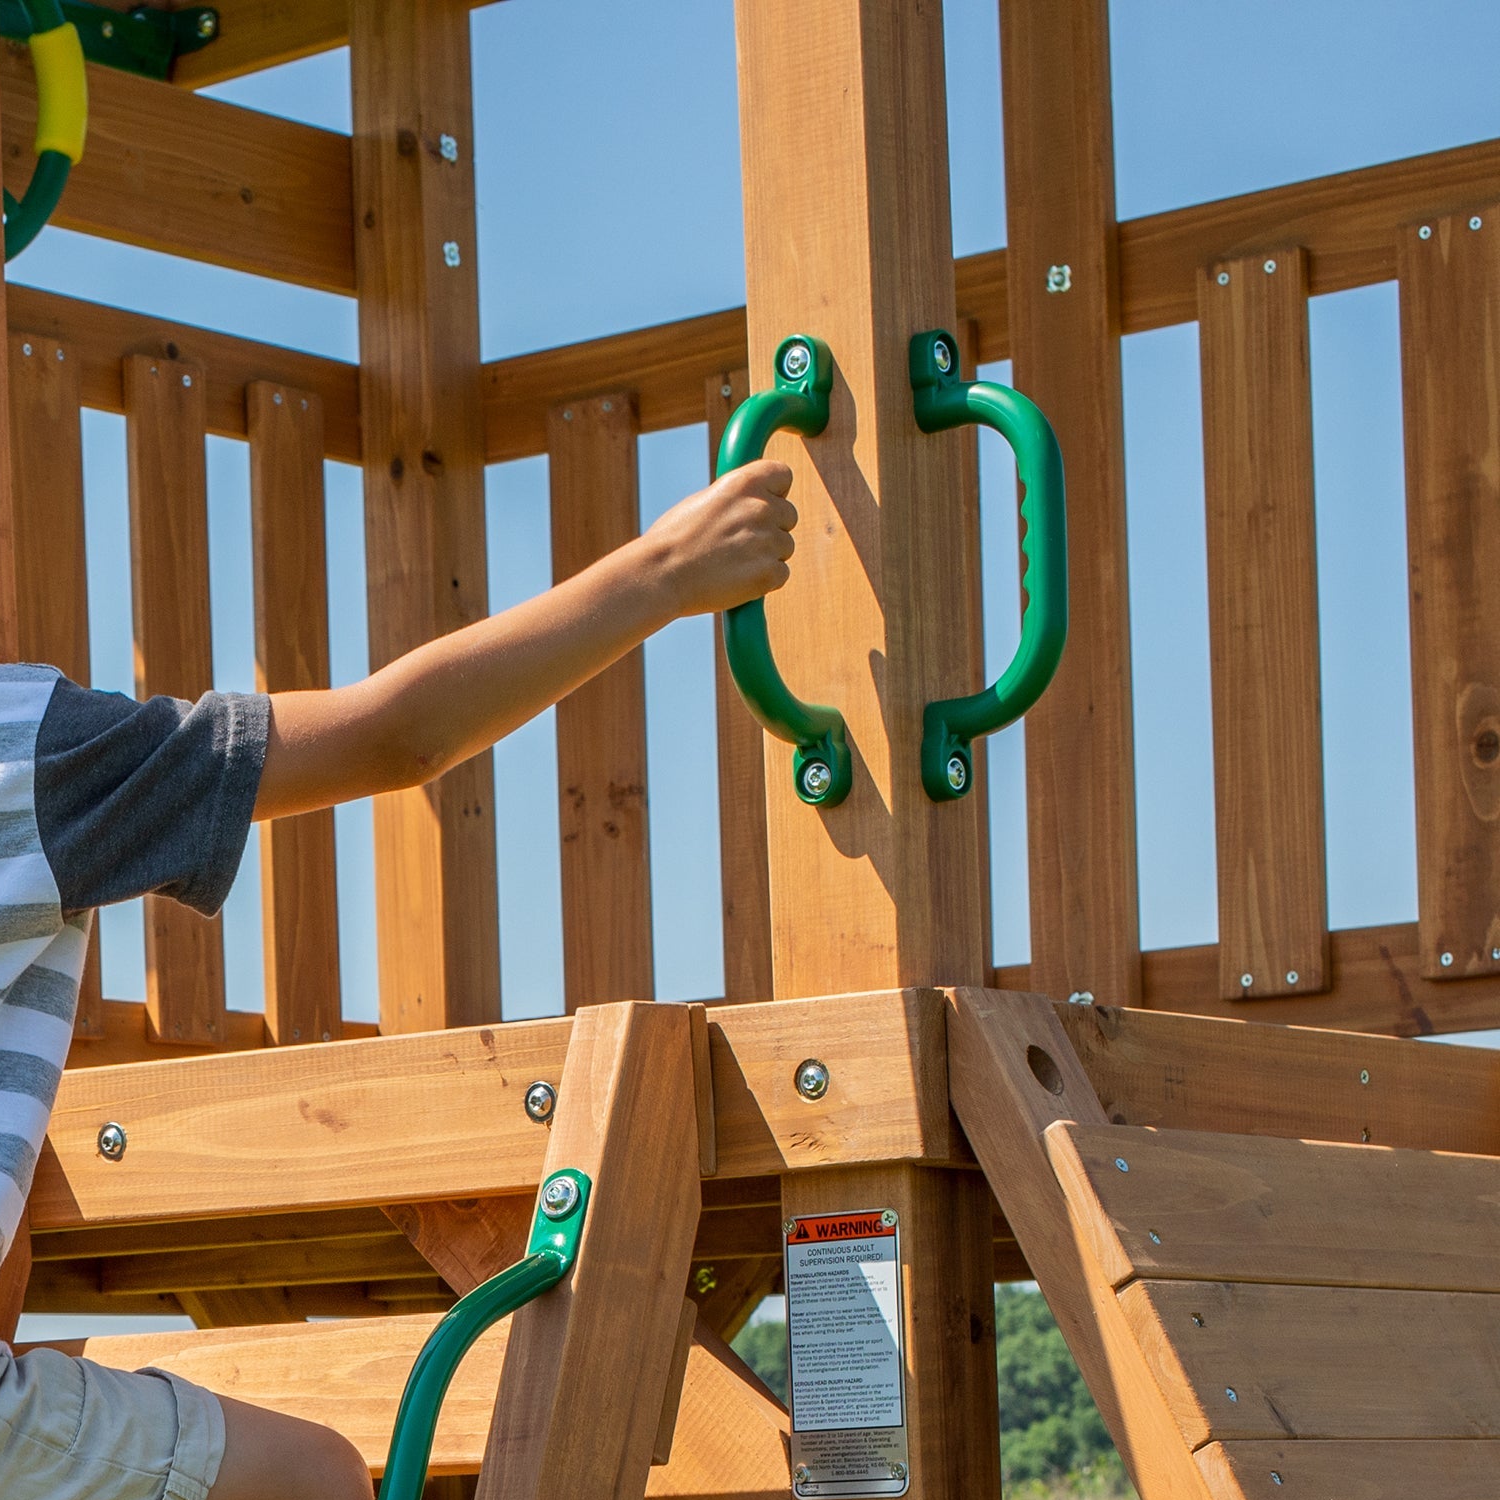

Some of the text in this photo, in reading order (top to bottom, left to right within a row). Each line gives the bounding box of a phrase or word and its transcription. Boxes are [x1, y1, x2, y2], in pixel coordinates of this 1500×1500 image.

[816, 1220, 883, 1238] WARNING
[807, 1244, 874, 1257] CONTINUOUS ADULT
[799, 1253, 883, 1267] SUPERVISION REQUIRED!
[790, 1271, 826, 1279] STRANGULATION
